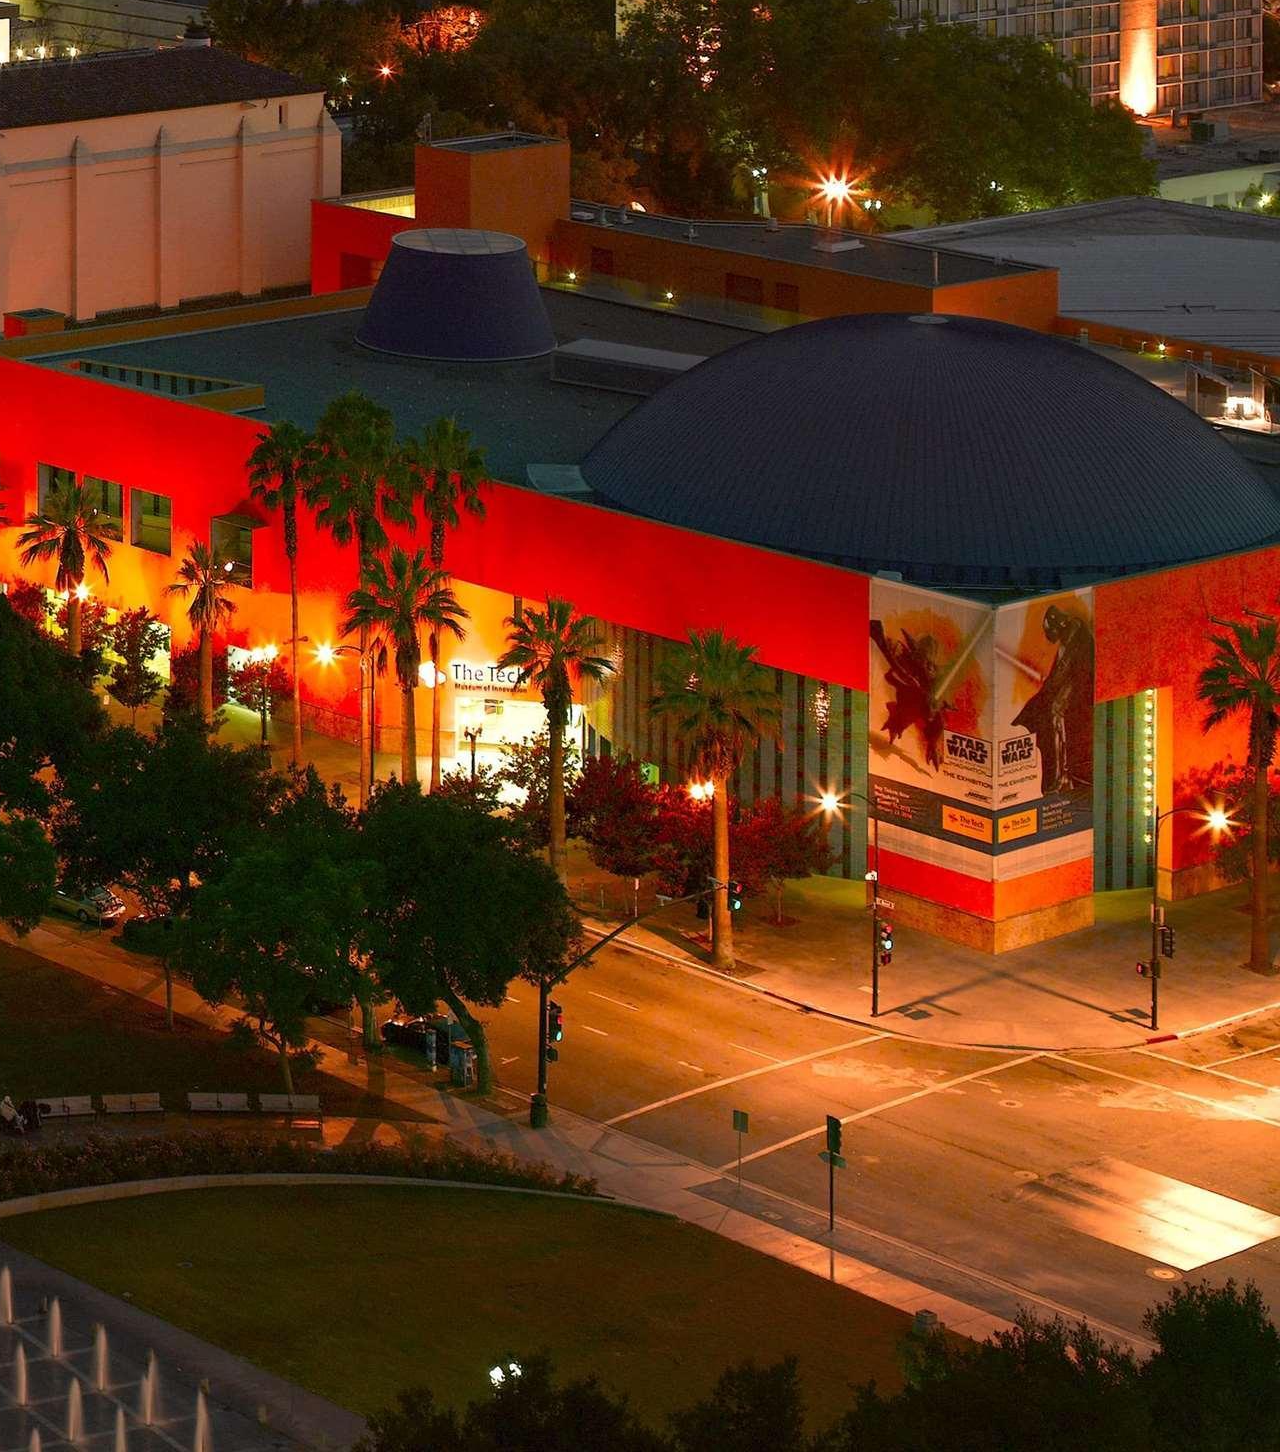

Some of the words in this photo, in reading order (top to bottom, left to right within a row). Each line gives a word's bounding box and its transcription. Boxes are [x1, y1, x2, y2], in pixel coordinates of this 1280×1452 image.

[452, 664, 484, 682] The
[454, 683, 483, 692] Museum
[947, 734, 988, 754] STAR
[1001, 737, 1033, 754] STAR
[947, 743, 988, 764] WARS
[1001, 748, 1033, 765] WARS
[943, 770, 956, 779] THE
[960, 815, 971, 825] The
[971, 819, 984, 829] Tech
